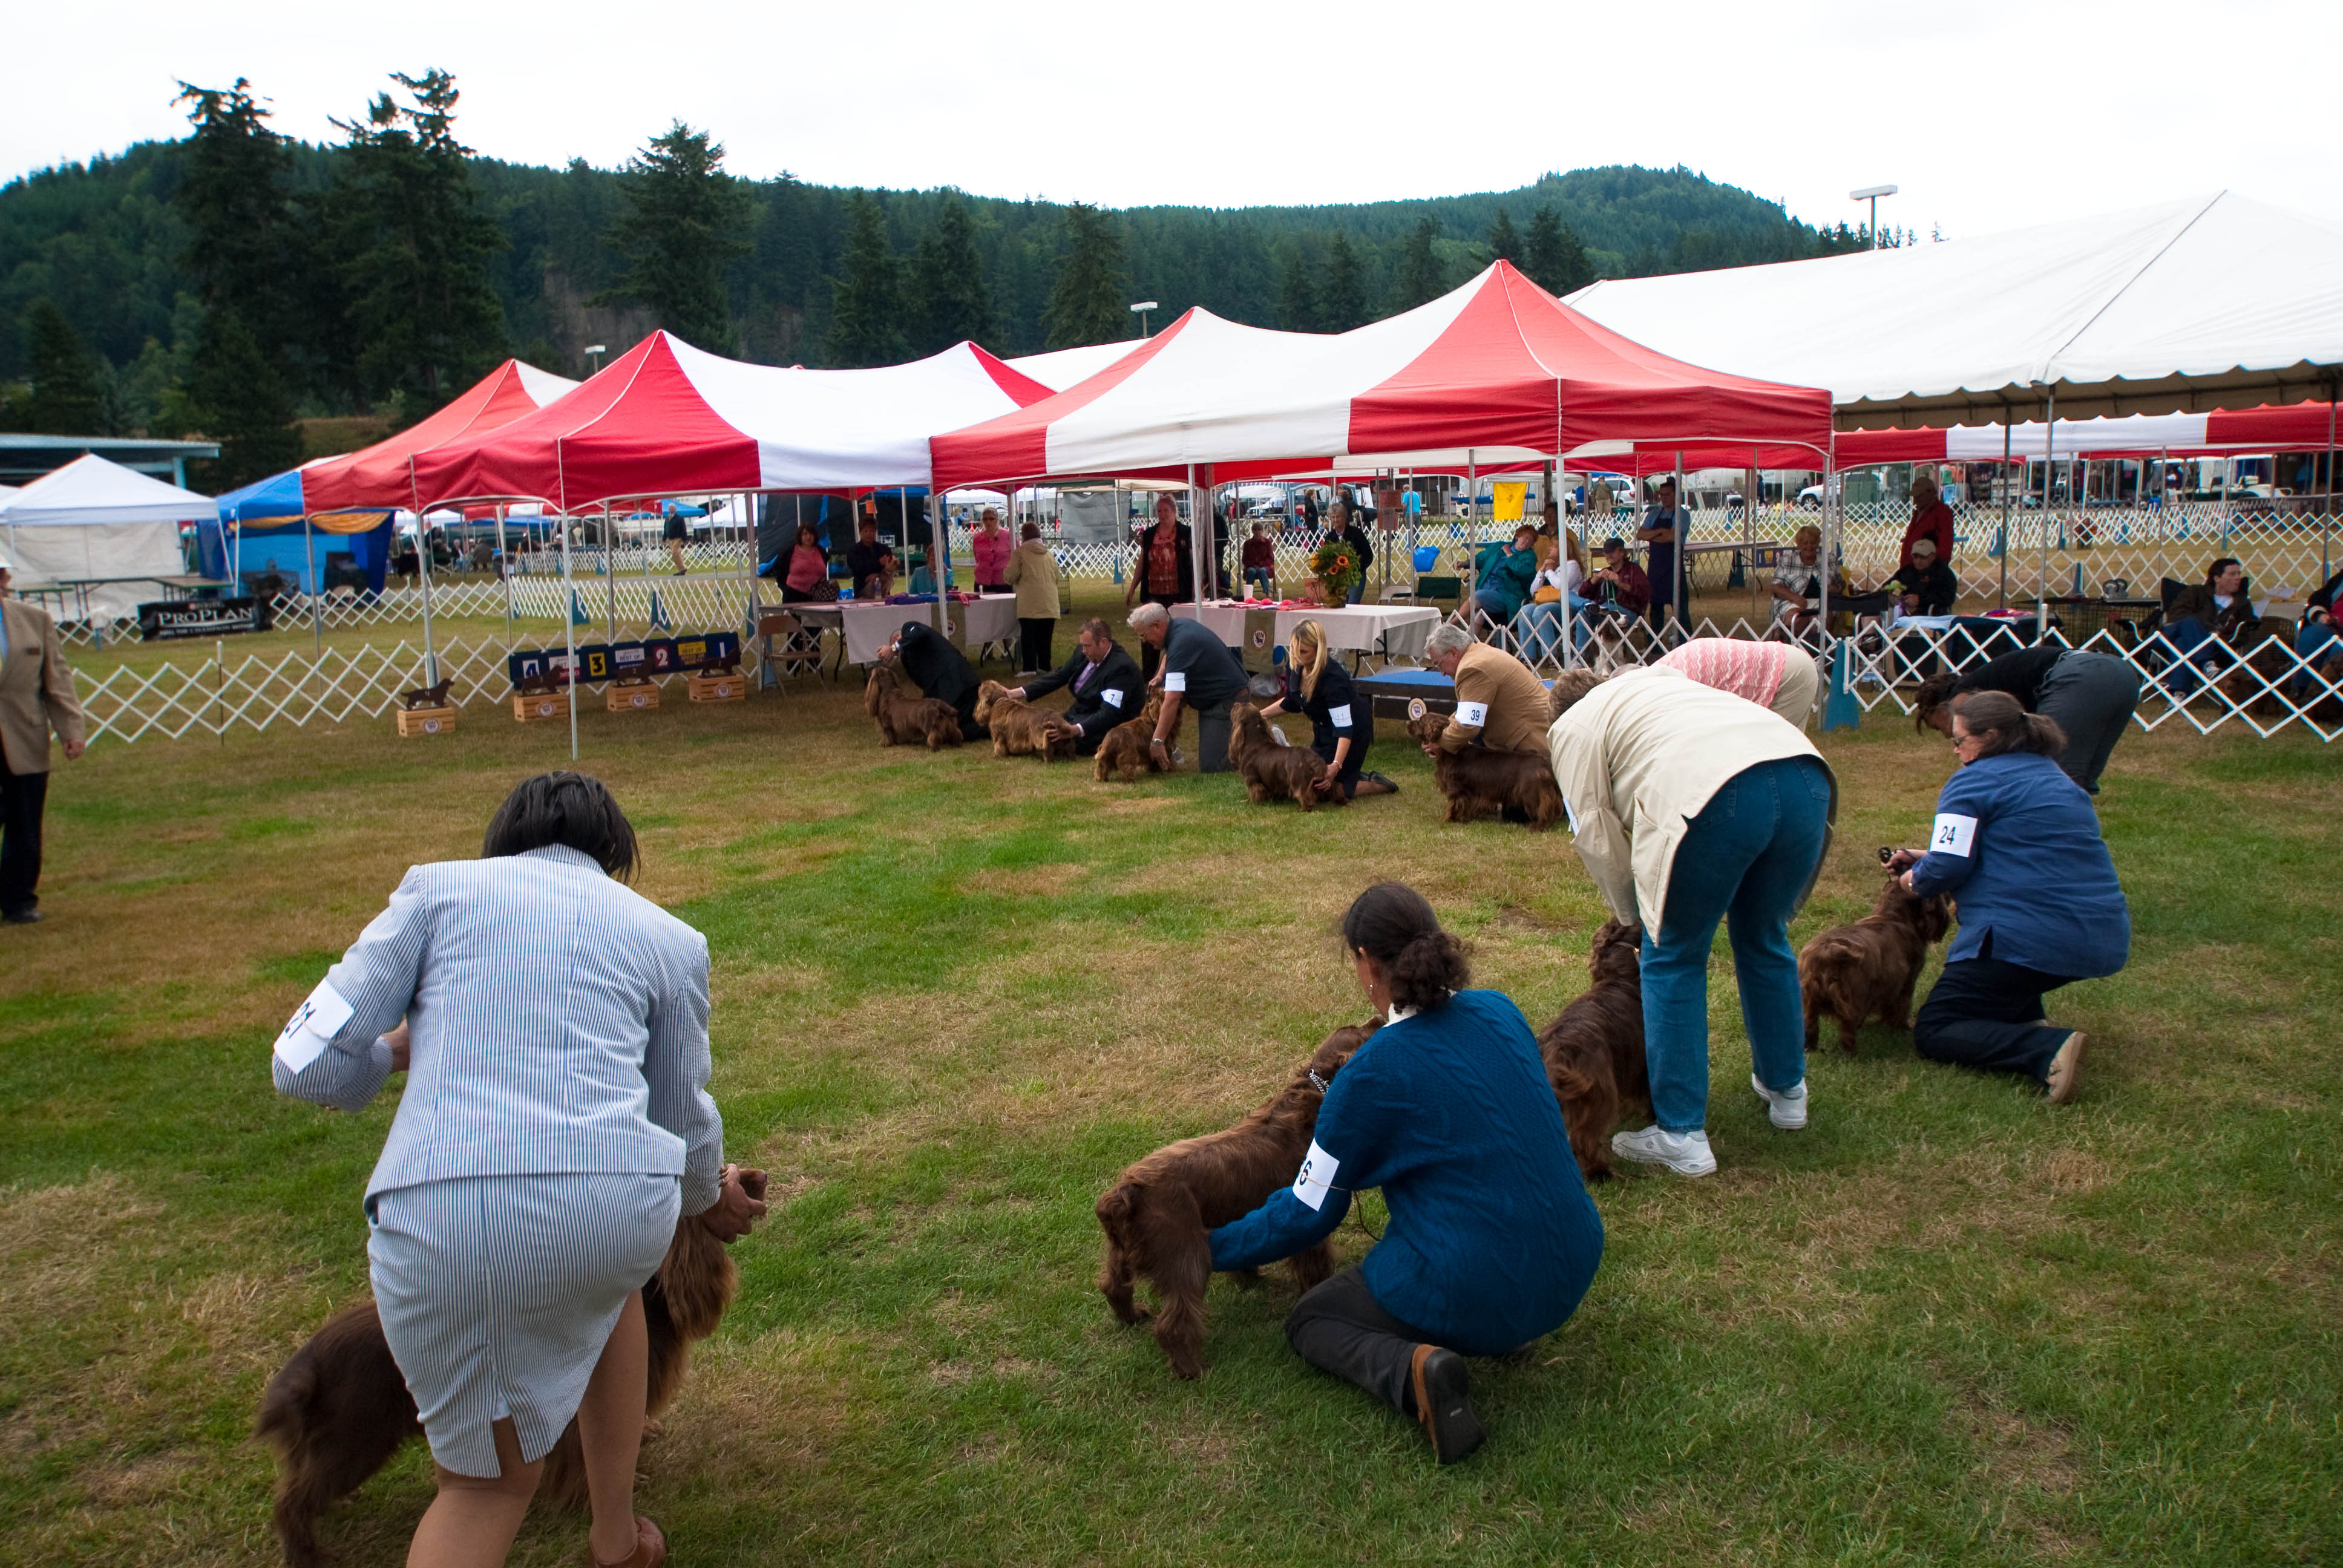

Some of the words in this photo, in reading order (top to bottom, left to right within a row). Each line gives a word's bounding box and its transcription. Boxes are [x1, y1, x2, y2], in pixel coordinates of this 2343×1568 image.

[592, 656, 603, 673] 3
[656, 648, 668, 666] 2
[1111, 694, 1115, 702] 7
[1470, 709, 1480, 721] 39
[1939, 825, 1956, 845] 24
